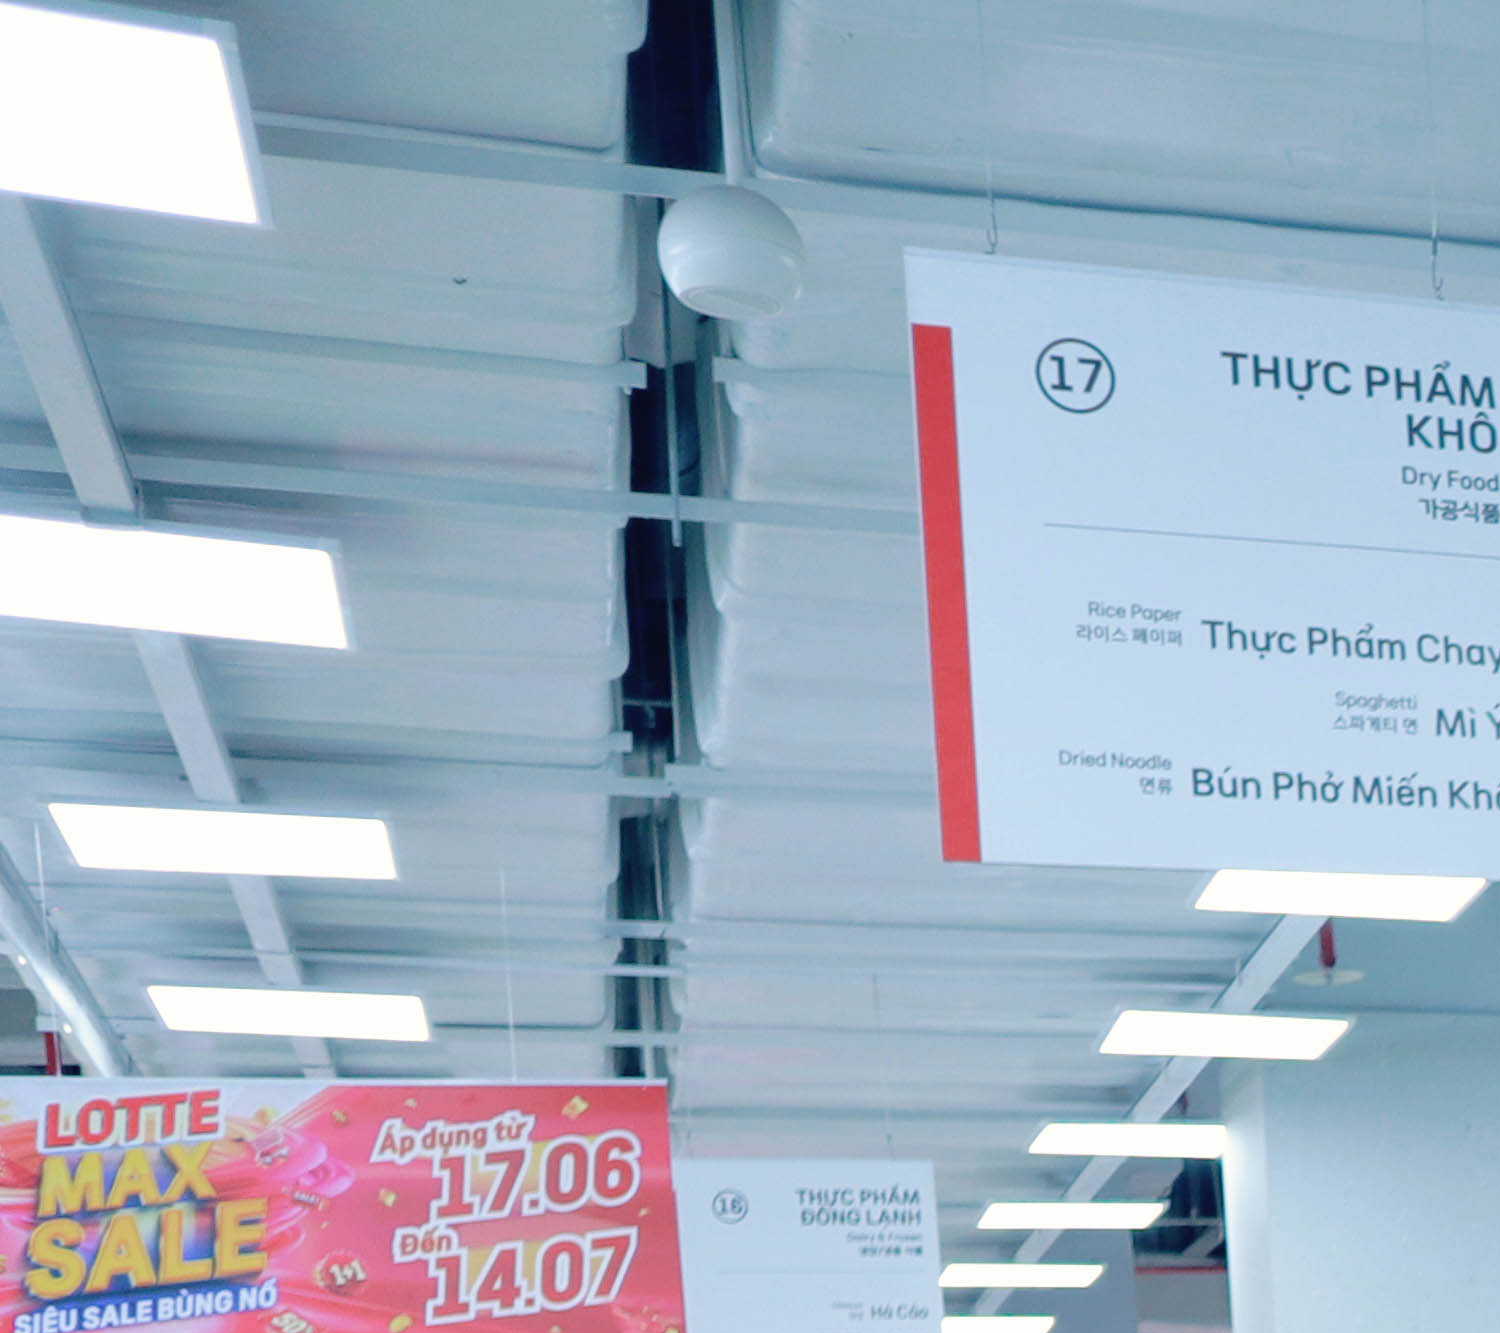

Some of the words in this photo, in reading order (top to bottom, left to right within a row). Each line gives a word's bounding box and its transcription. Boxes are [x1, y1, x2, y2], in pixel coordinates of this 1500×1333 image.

[1049, 355, 1102, 394] 17
[1221, 351, 1352, 401] THỰC
[1364, 361, 1496, 409] PHẨM
[1406, 414, 1498, 454] KHÔ
[1401, 467, 1441, 492] Dry
[1448, 470, 1500, 492] Food
[1419, 499, 1500, 525] 가공식품
[1088, 601, 1126, 619] Rice
[1129, 604, 1182, 625] Paper
[1201, 620, 1298, 661] Thực
[1308, 624, 1407, 664] Phẩm
[1335, 691, 1418, 714] Spaghetti
[1435, 708, 1476, 740] Mì
[1058, 749, 1104, 769] Dried
[1108, 752, 1173, 772] Noodle
[1192, 768, 1261, 801] Bún
[1273, 771, 1342, 804] Phở
[1352, 769, 1438, 809] Miến
[44, 1089, 221, 1148] LOTTE
[377, 1122, 415, 1162] Áp
[416, 1122, 487, 1159] dụng
[494, 1115, 531, 1143] từ
[36, 1142, 219, 1219] MAX
[436, 1138, 639, 1220] 17.06
[720, 1198, 742, 1214] 16
[796, 1188, 854, 1208] THỰC
[860, 1184, 920, 1206] PHẨM
[801, 1208, 860, 1226] ĐÔNG
[866, 1210, 922, 1229] LẠNH
[27, 1200, 269, 1301] SALE
[401, 1228, 452, 1258] Đến
[430, 1232, 633, 1320] 14.07
[83, 1301, 153, 1332] SALE
[159, 1289, 234, 1323] BÙNG
[238, 1278, 278, 1313] NỔ
